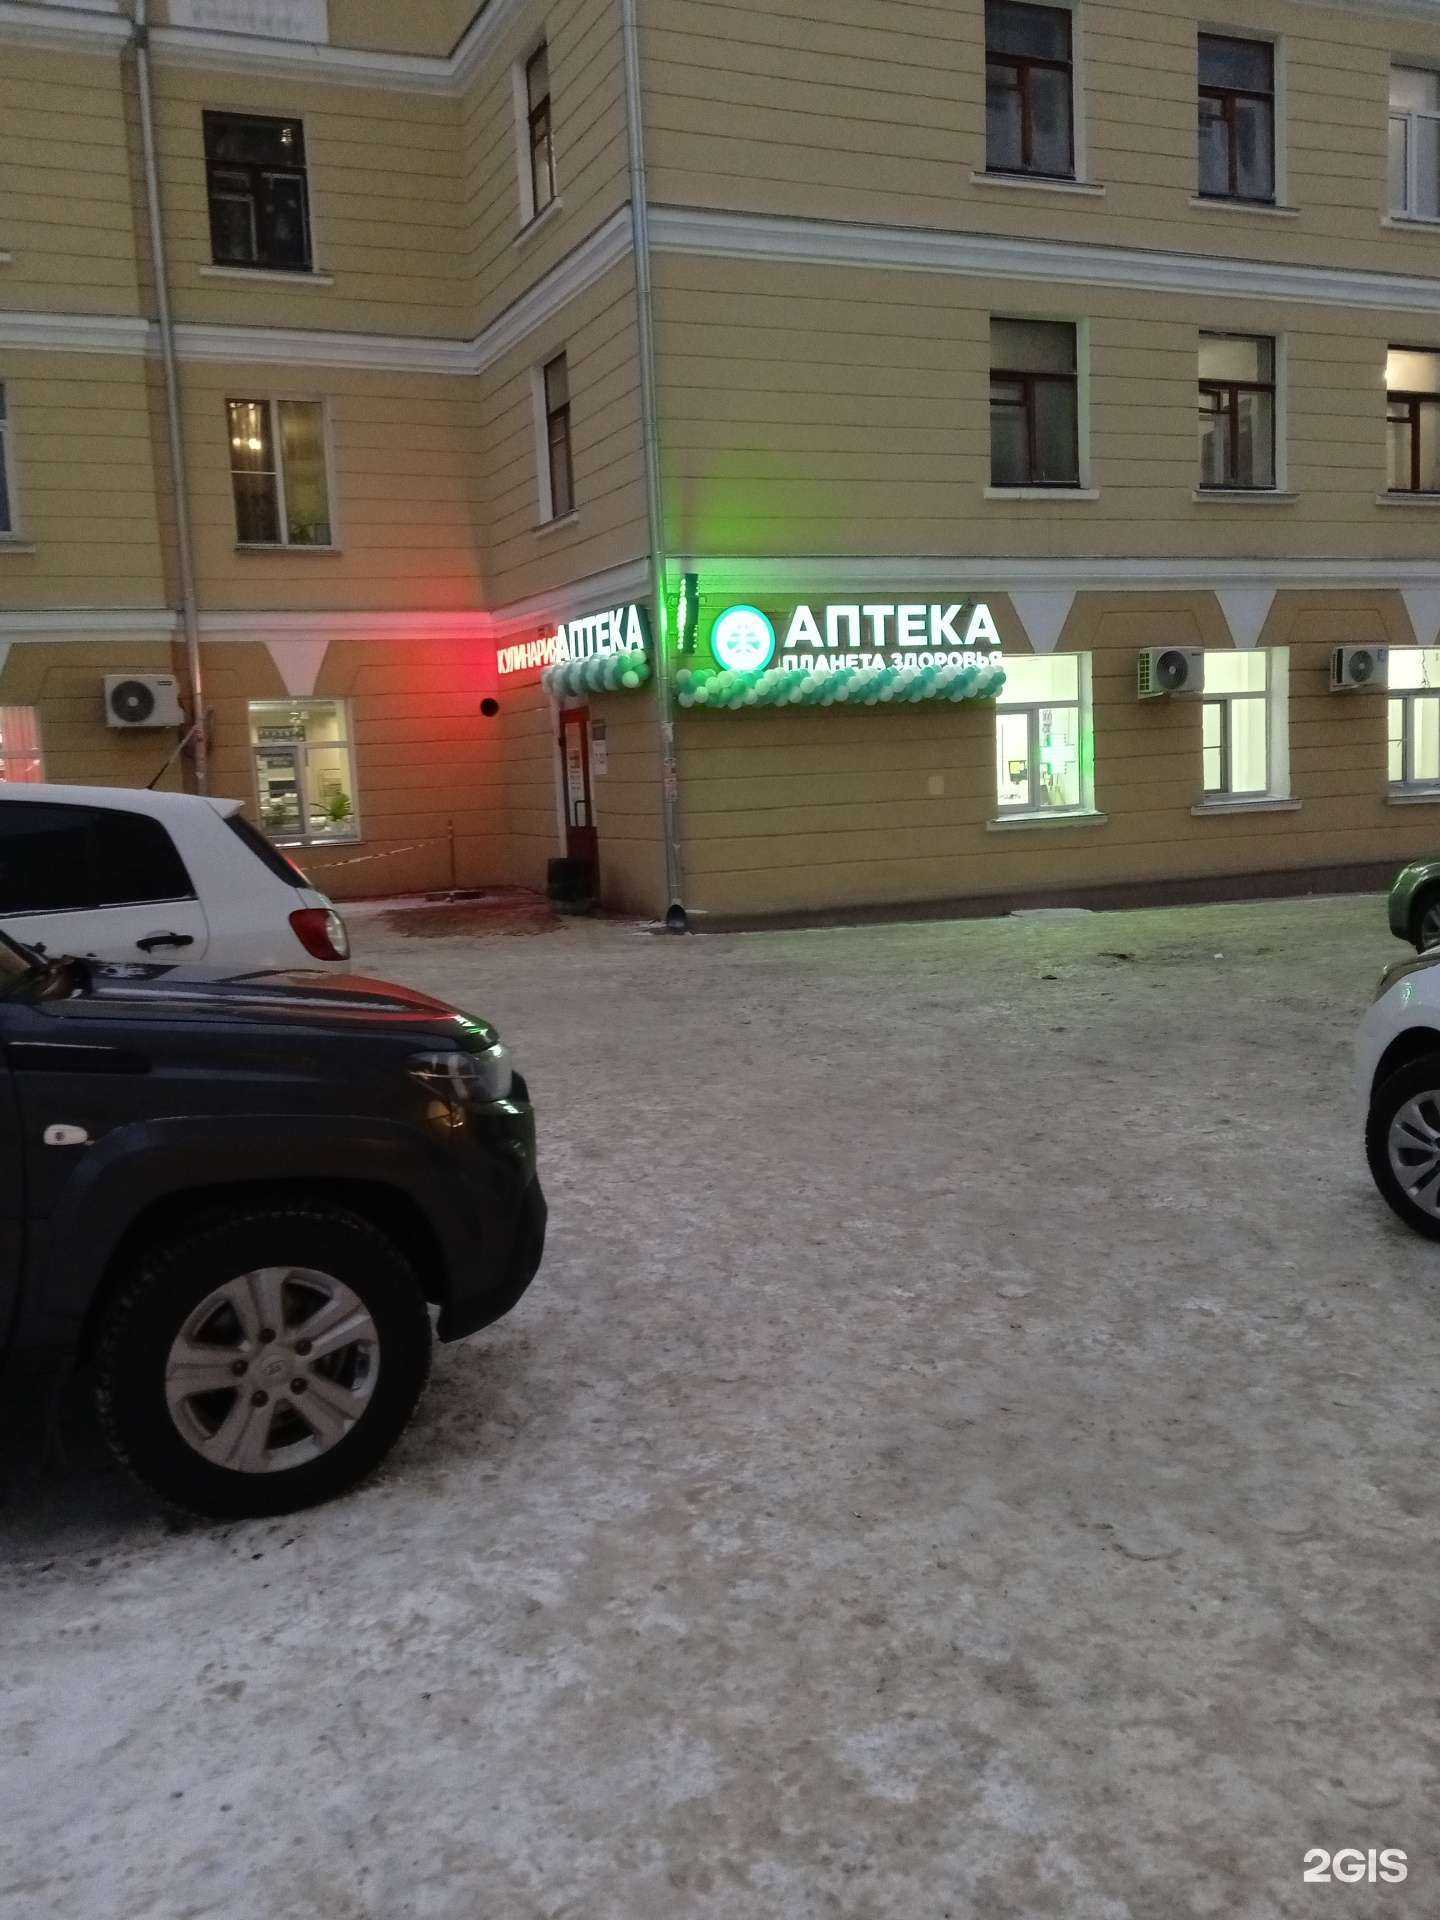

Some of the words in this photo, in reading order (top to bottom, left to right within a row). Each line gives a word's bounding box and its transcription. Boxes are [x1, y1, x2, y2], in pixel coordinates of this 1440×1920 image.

[556, 604, 643, 660] АПТЕКА
[783, 603, 1001, 648] АПТЕКА
[782, 653, 886, 671] ПЛАНЕТА
[891, 651, 1003, 669] ЗДОРОВЬЯ
